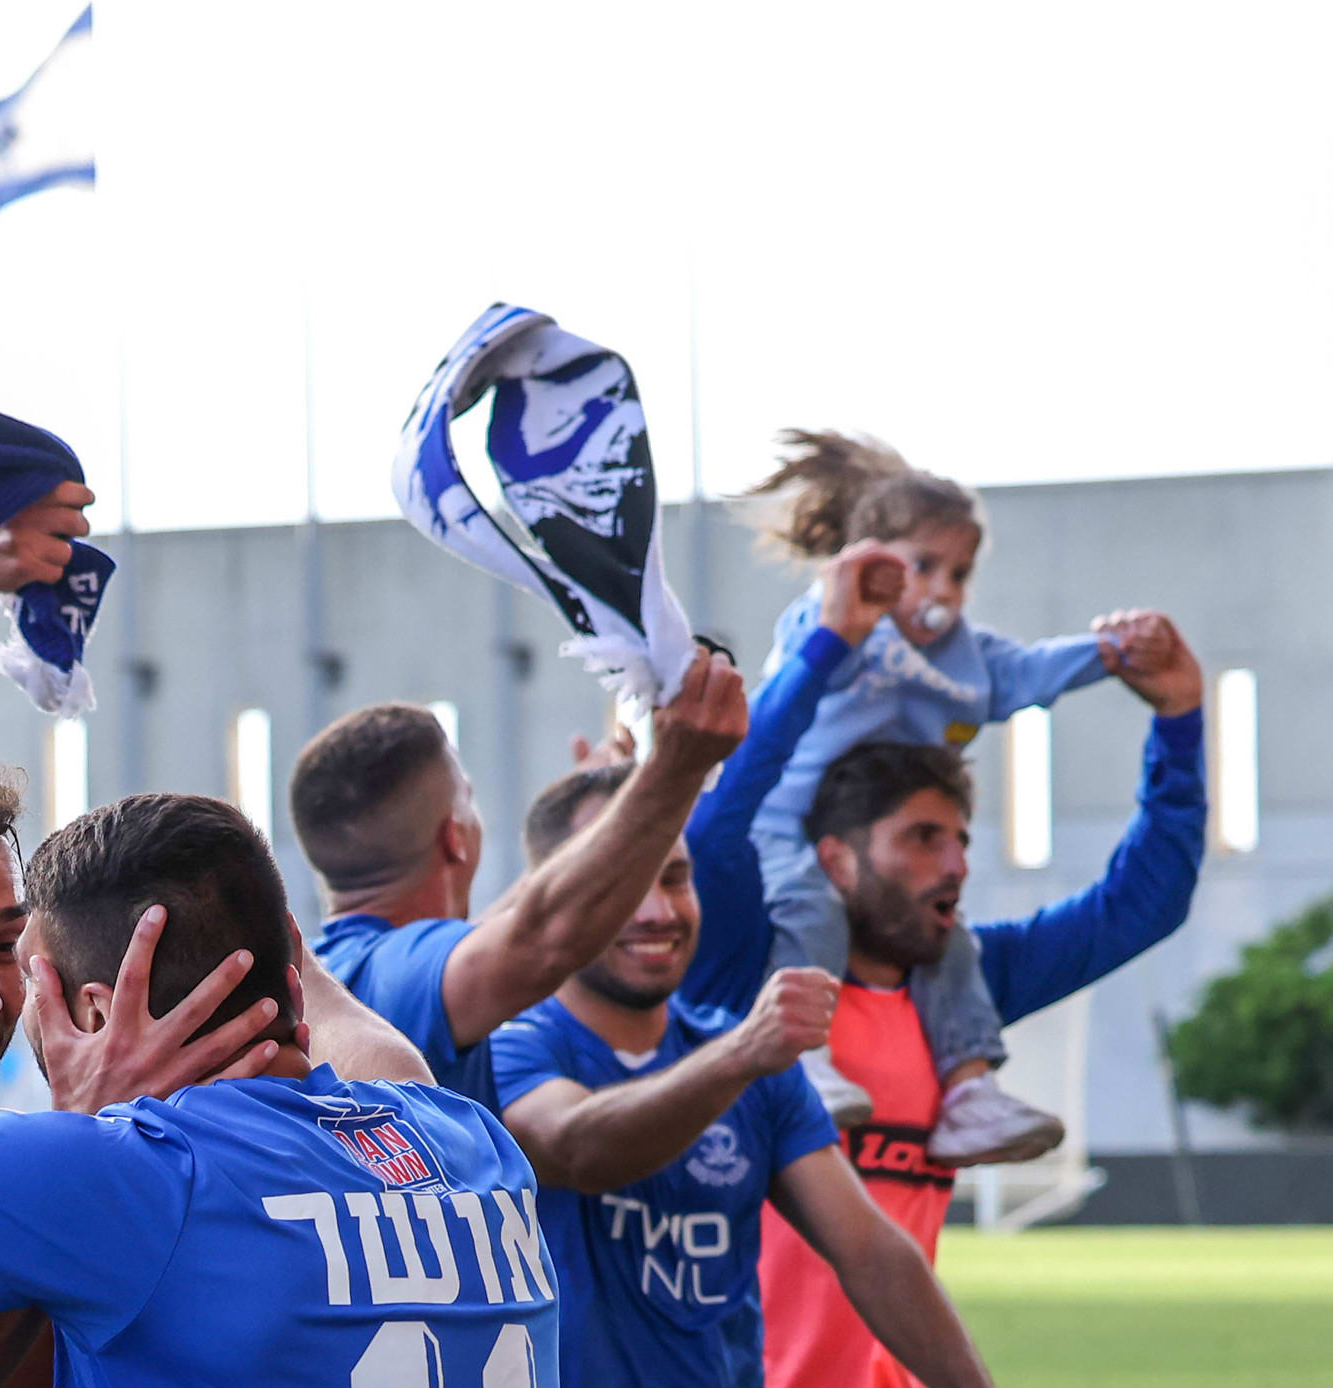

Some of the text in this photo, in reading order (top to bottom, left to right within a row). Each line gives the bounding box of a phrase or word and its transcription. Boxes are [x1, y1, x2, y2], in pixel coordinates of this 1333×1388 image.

[369, 1148, 431, 1186] OWN
[261, 1188, 555, 1305] אושר
[641, 1254, 728, 1304] NL
